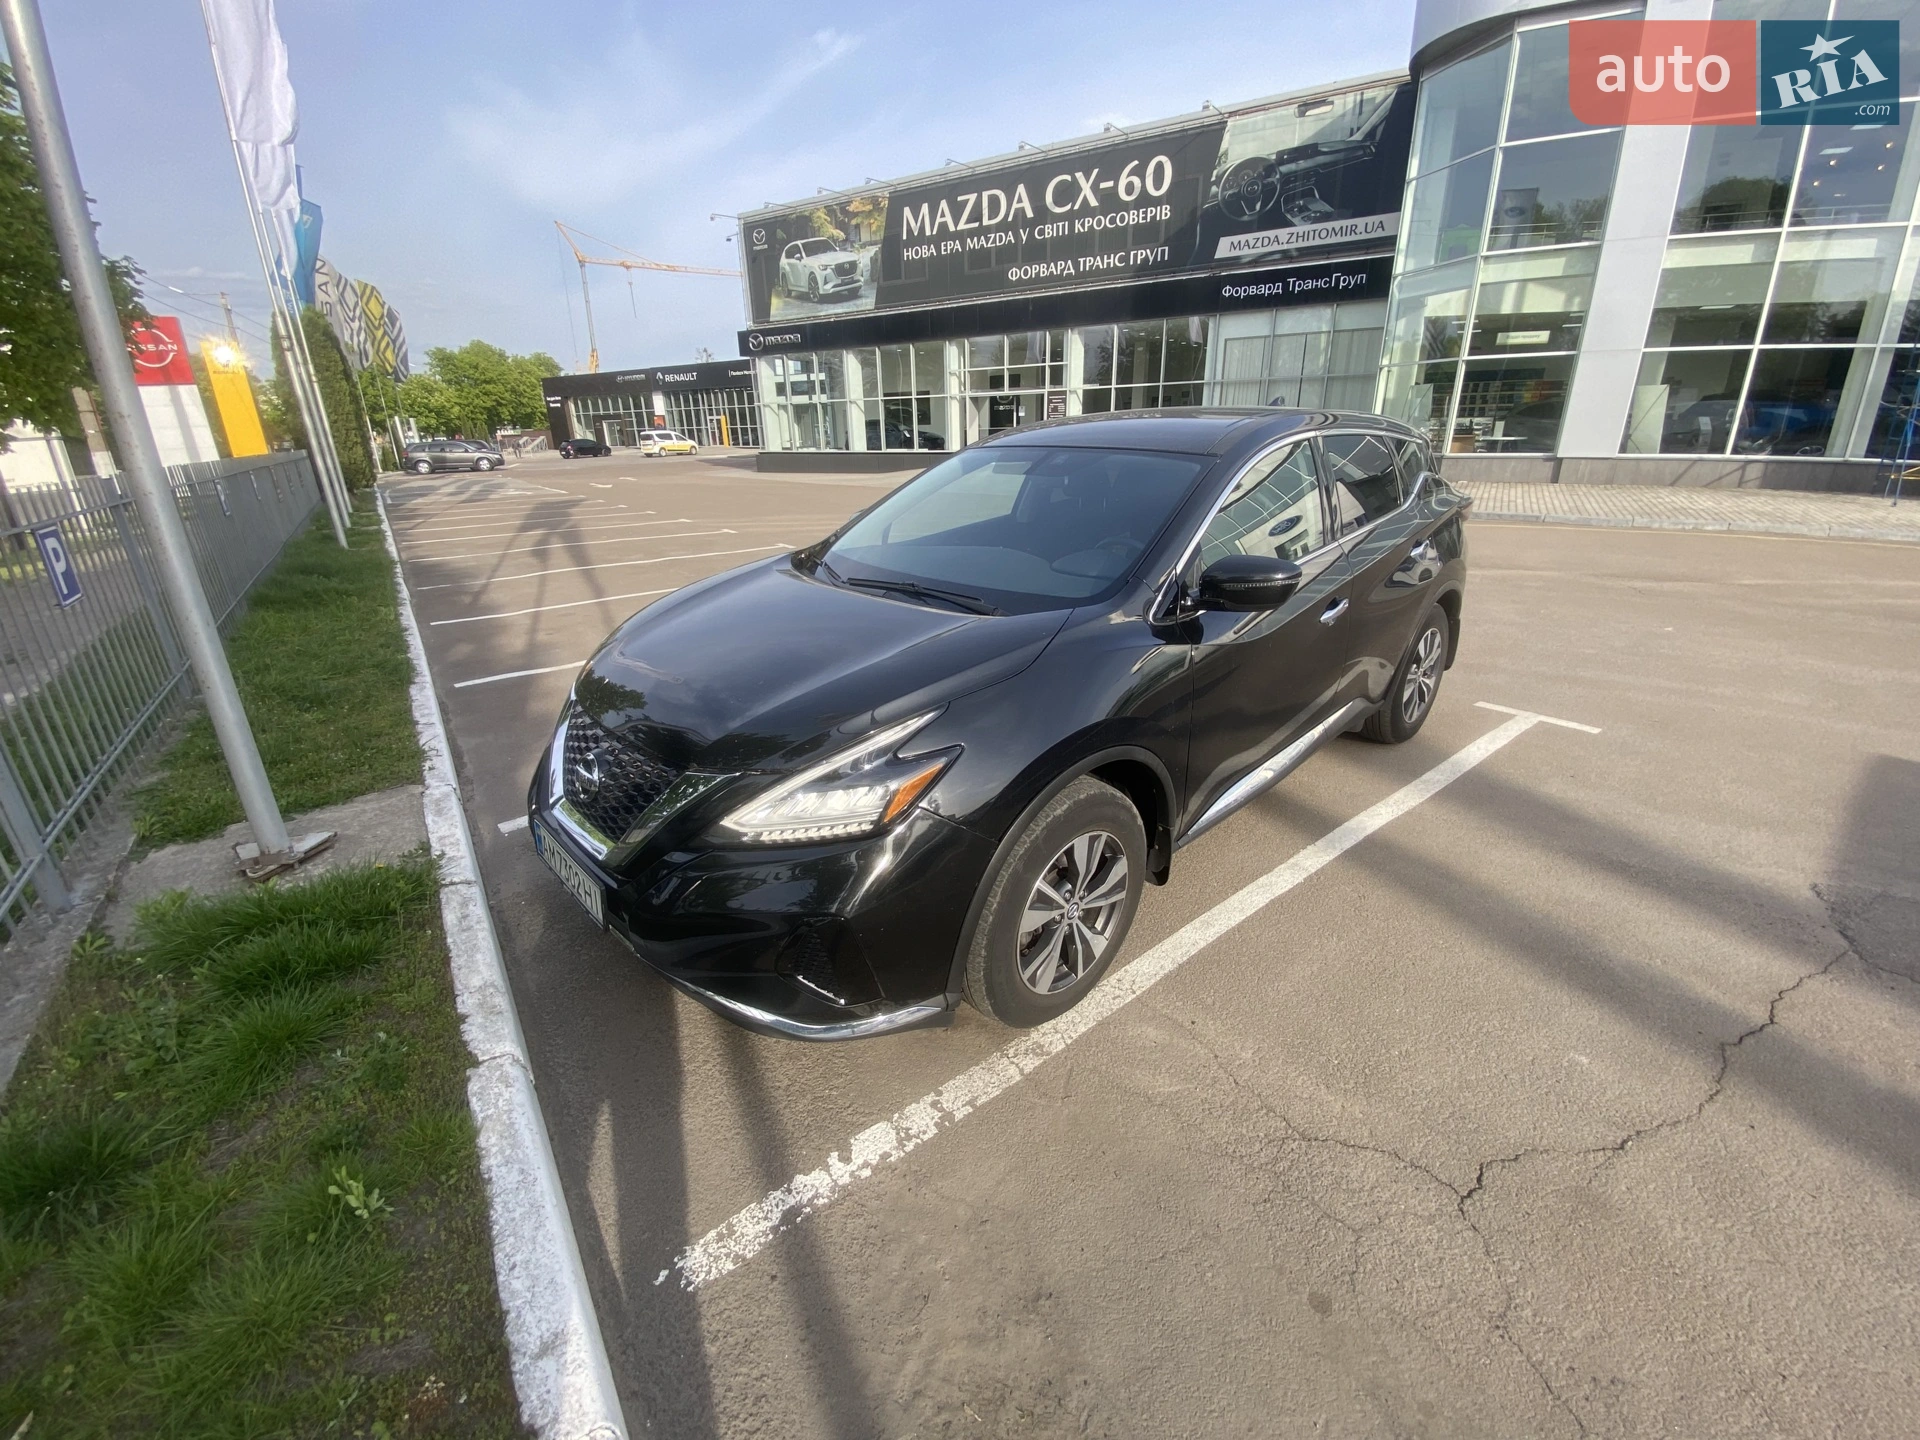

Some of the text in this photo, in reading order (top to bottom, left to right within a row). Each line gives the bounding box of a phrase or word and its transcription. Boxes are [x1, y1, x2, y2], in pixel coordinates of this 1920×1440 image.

[902, 154, 1173, 240] MAZDA CX-60
[903, 204, 1171, 261] НОВА ЕРА MAZDA У СВІТІ КРОСОВЕРІВ
[1228, 220, 1386, 253] MAZDA.ZHITOMIR.UA
[1007, 246, 1169, 282] ФОРВАРД ТРАНС ГРУП
[1221, 281, 1283, 299] Форвард
[664, 372, 698, 383] RENAULT
[44, 537, 68, 595] P
